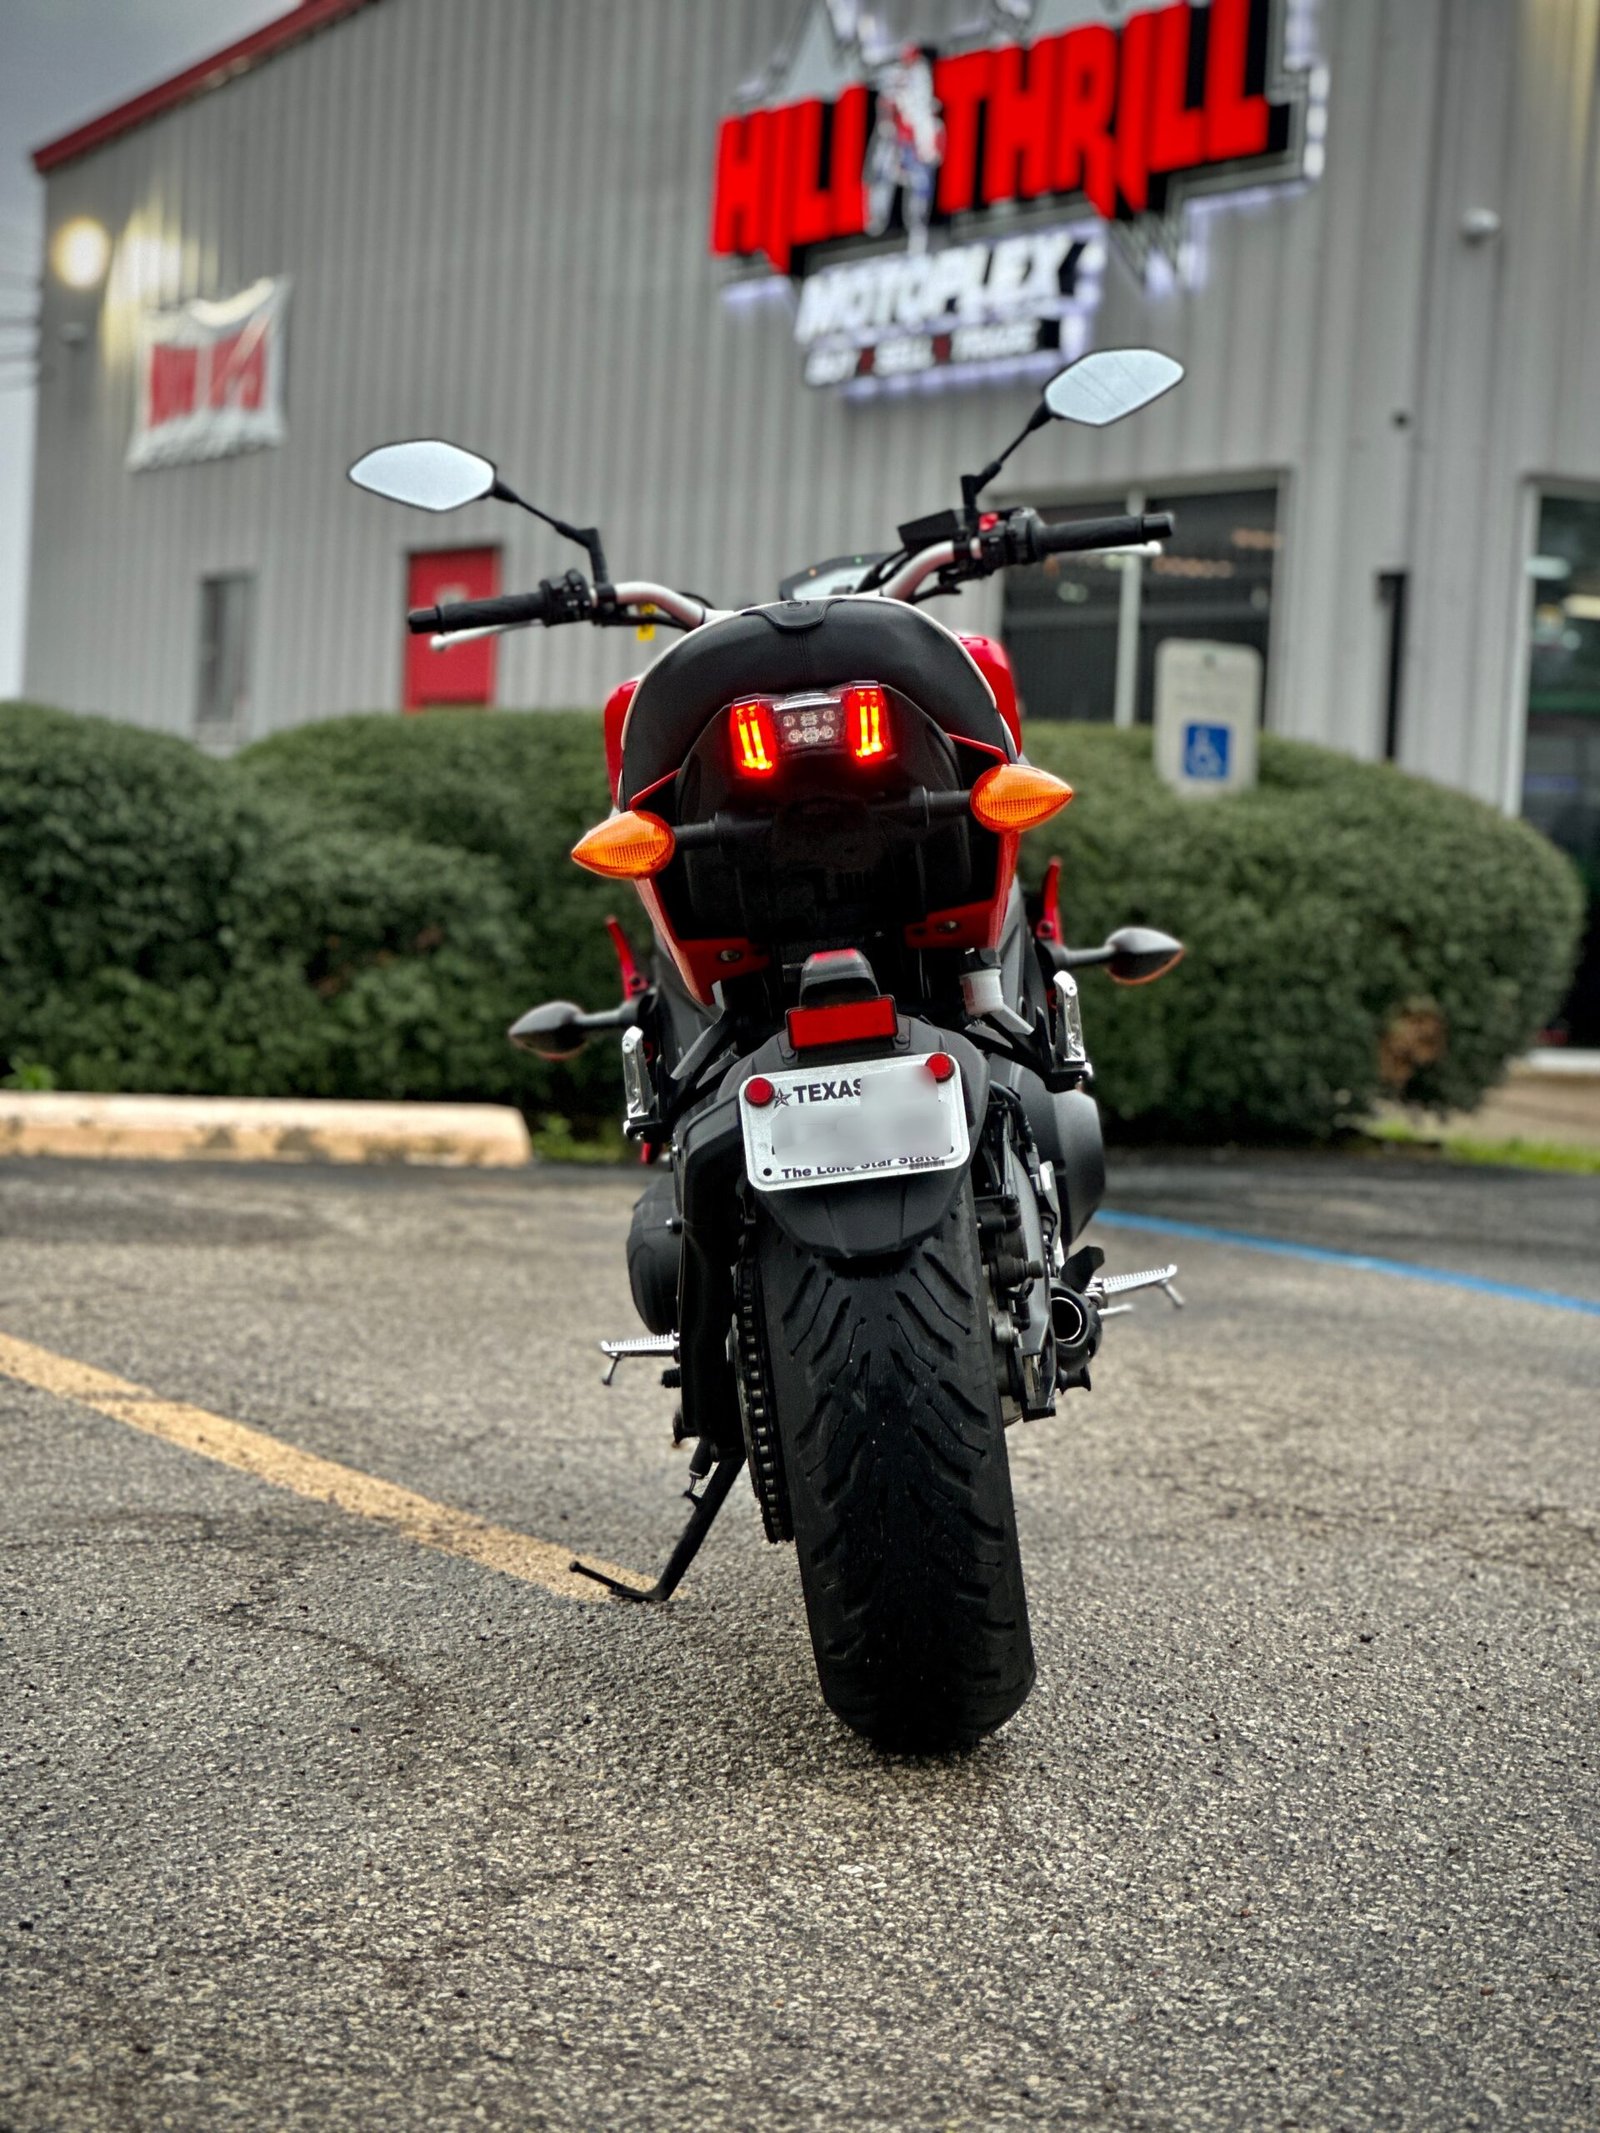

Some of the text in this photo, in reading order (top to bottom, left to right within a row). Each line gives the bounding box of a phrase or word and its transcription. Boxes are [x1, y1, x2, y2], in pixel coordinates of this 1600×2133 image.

[711, 0, 1269, 275] HILL THRILL
[793, 1078, 862, 1103] TEXAS
[781, 1167, 812, 1179] The
